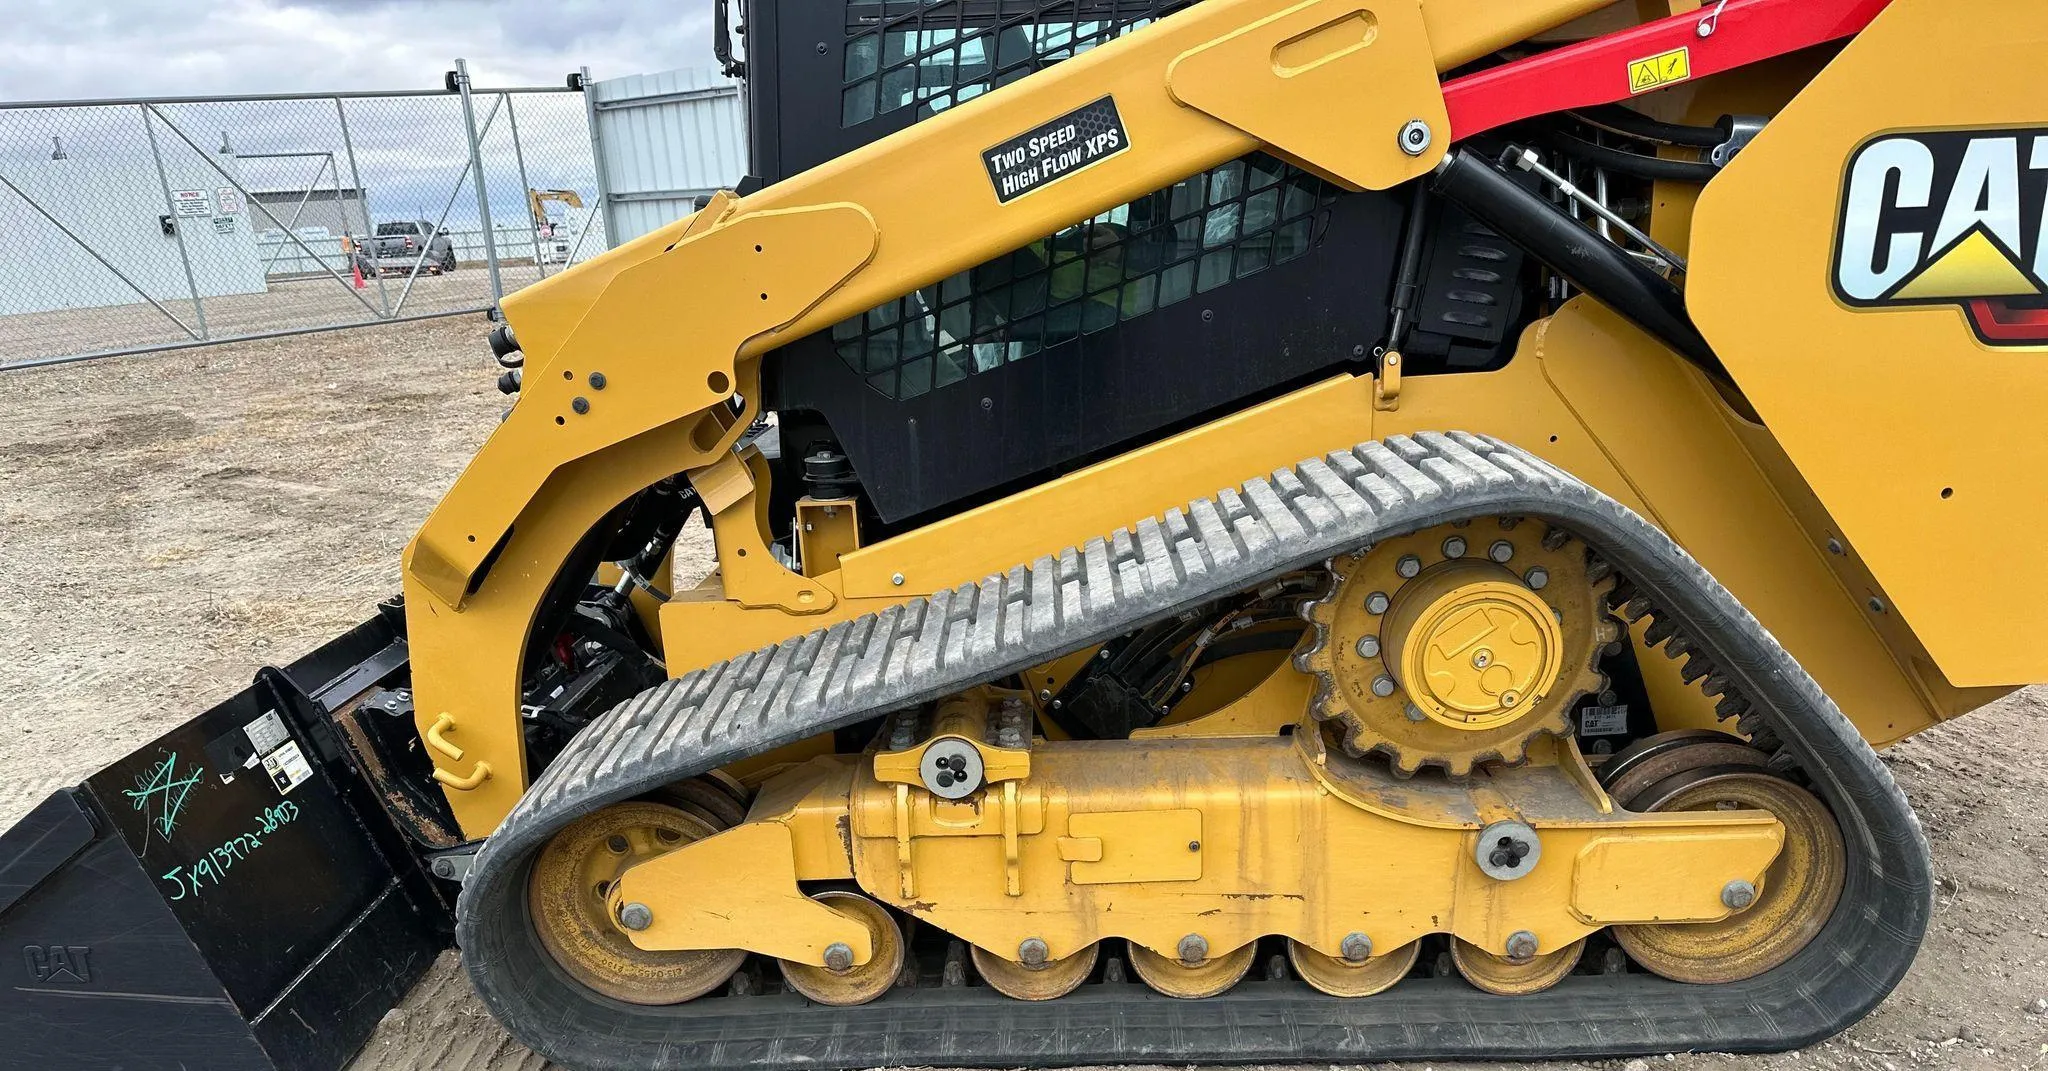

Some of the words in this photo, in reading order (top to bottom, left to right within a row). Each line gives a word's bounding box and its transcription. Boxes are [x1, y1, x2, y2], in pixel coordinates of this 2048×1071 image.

[991, 146, 1026, 174] TWO
[1028, 124, 1076, 158] SPEED
[1002, 166, 1039, 196] HIGH
[1041, 146, 1081, 178] FLOW
[1085, 128, 1119, 159] XPS
[1839, 135, 2048, 300] CA
[23, 945, 91, 983] CAT
